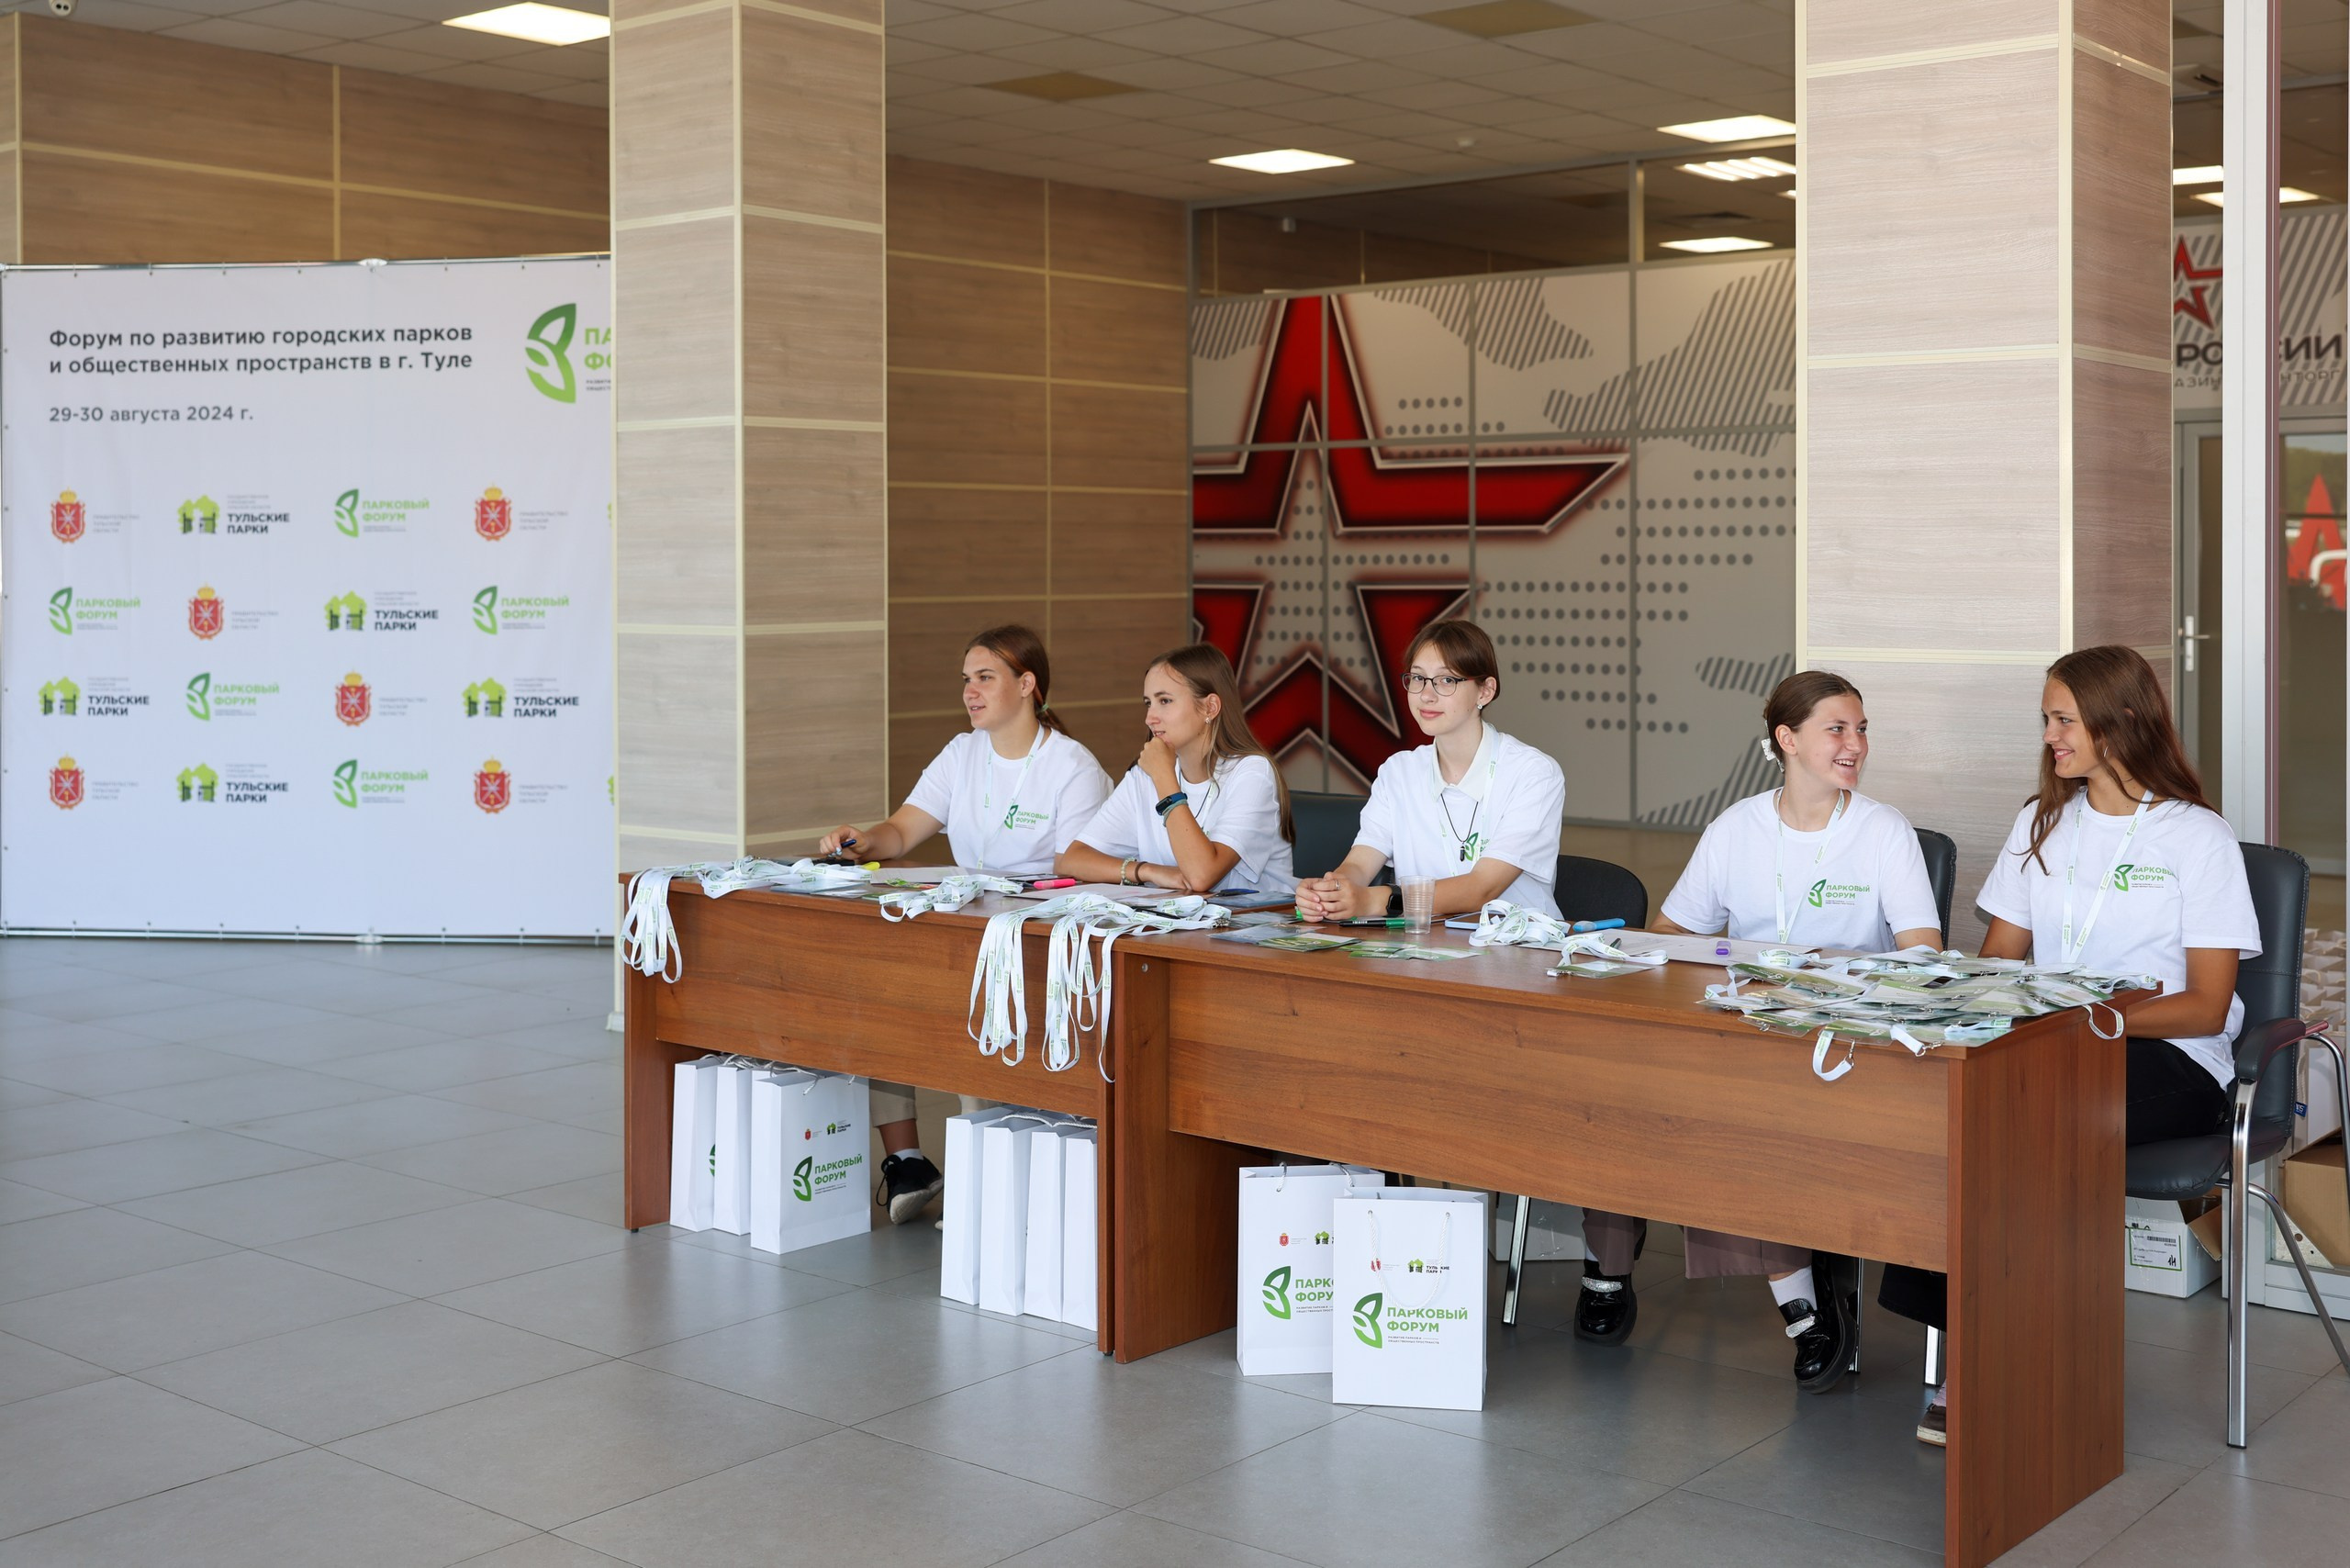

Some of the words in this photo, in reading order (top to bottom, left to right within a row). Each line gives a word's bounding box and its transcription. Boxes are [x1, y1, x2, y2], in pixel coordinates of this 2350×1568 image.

[50, 330, 123, 350] Форум
[129, 331, 156, 346] по
[162, 330, 265, 349] развитию
[273, 328, 386, 347] городских
[393, 327, 473, 344] парков
[50, 359, 62, 373] и
[69, 356, 229, 375] общественных
[236, 355, 373, 374] пространств
[379, 354, 391, 369] в
[398, 354, 414, 368] г.
[420, 352, 473, 371] Туле
[49, 407, 104, 422] 29-30
[109, 408, 181, 425] августа
[186, 405, 234, 421] 2024
[240, 408, 254, 421] г.
[362, 499, 430, 510] ПАРКОВЫЙ
[227, 512, 290, 522] ТУЛЬСКИЕ
[362, 512, 407, 522] ФОРУМ
[227, 524, 269, 534] ПАРКИ
[75, 596, 141, 610] ПАРКОВЫЙ
[500, 596, 570, 607] ПАРКОВЫЙ
[75, 610, 118, 621] ФОРУМ
[374, 609, 439, 620] ТУЛЬСКИЕ
[500, 609, 545, 620] ФОРУМ
[374, 621, 417, 632] ПАРКИ
[213, 681, 280, 694] ПАРКОВЫЙ
[87, 695, 150, 705] ТУЛЬСКИЕ
[213, 696, 257, 707] ФОРУМ
[513, 696, 580, 707] ТУЛЬСКИЕ
[87, 706, 129, 716] ПАРКИ
[513, 708, 558, 718] ПАРКИ
[361, 768, 430, 781] ПАРКОВЫЙ
[225, 781, 289, 792] ТУЛЬСКИЕ
[361, 782, 406, 794] ФОРУМ
[225, 793, 267, 803] ПАРКИ
[2131, 874, 2165, 882] ФОРУМ
[1826, 883, 1871, 893] ПАРКОВЫЙ
[1825, 891, 1856, 900] ФОРУМ
[815, 1154, 862, 1174] ПАРКОВЫЙ
[815, 1170, 846, 1185] ФОРУМ
[1295, 1277, 1334, 1289] ПАРК
[1387, 1306, 1468, 1320] ПАРКОВЫЙ
[1386, 1320, 1439, 1333] ФОРУМ
